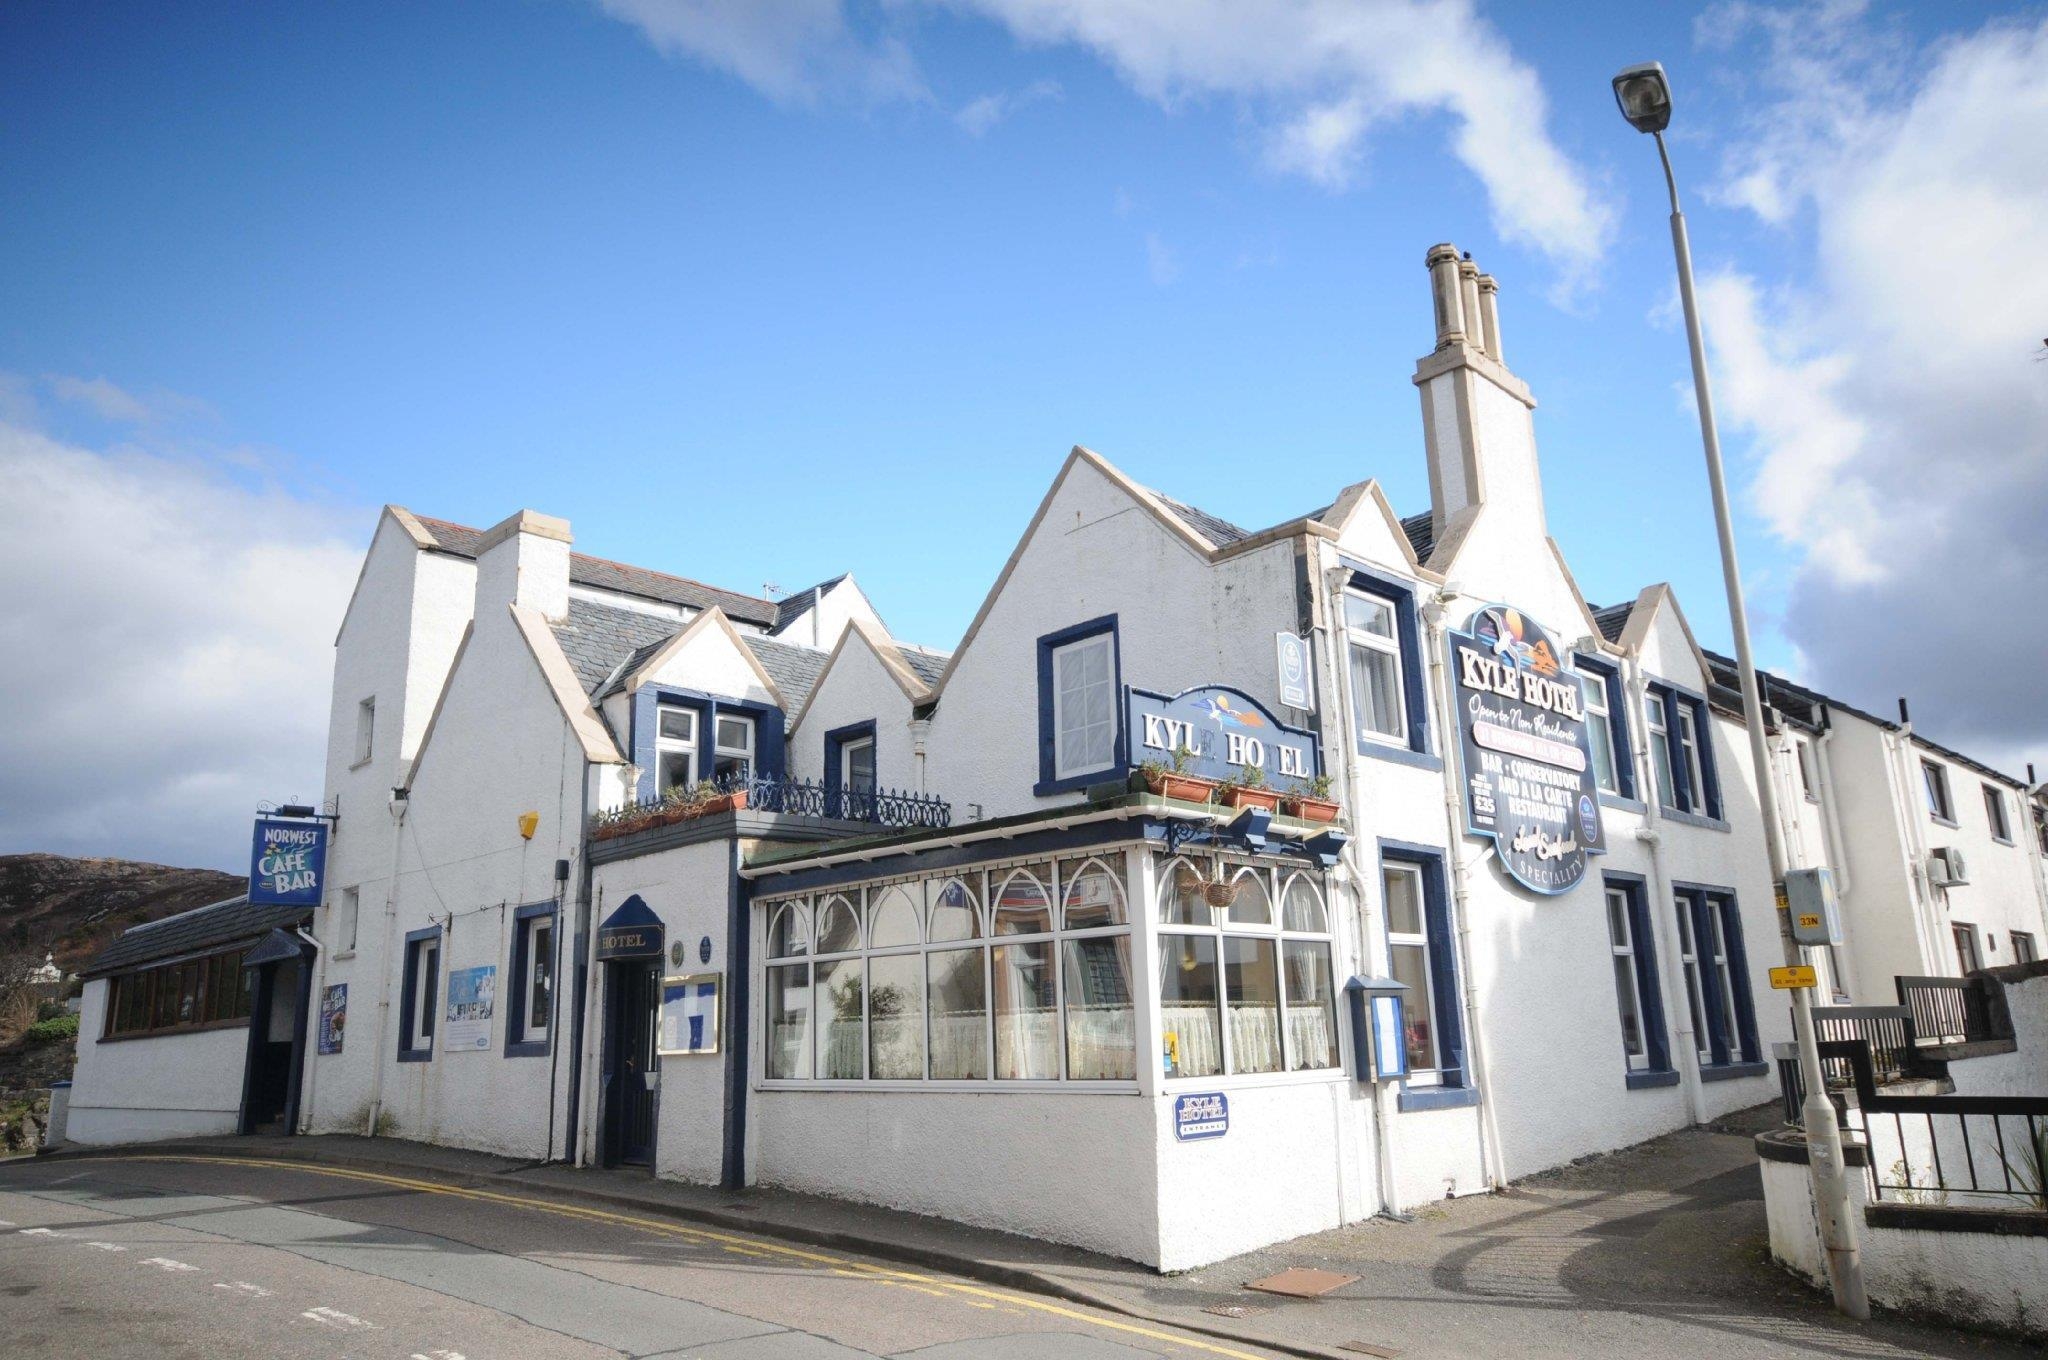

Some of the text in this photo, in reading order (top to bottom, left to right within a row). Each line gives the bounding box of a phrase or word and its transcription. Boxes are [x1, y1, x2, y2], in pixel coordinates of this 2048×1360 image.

[1459, 646, 1585, 722] KYLE HOTEL
[1469, 693, 1577, 741] Open to Non Residents
[1481, 752, 1503, 775] BAR
[1511, 760, 1581, 791] CONSERVATORY
[1498, 774, 1520, 796] AND
[1522, 781, 1529, 799] A
[1530, 783, 1543, 802] LA
[1544, 786, 1573, 808] CARTE
[1508, 796, 1567, 824] RESTAURANT
[264, 828, 319, 845] NORWEST
[1505, 847, 1583, 885] A SPECIALITY
[274, 870, 317, 894] BAR
[1799, 917, 1819, 926] 33N
[602, 935, 646, 950] HOTEL
[1179, 1106, 1227, 1122] HOTEL
[1183, 1096, 1222, 1110] KYLE
